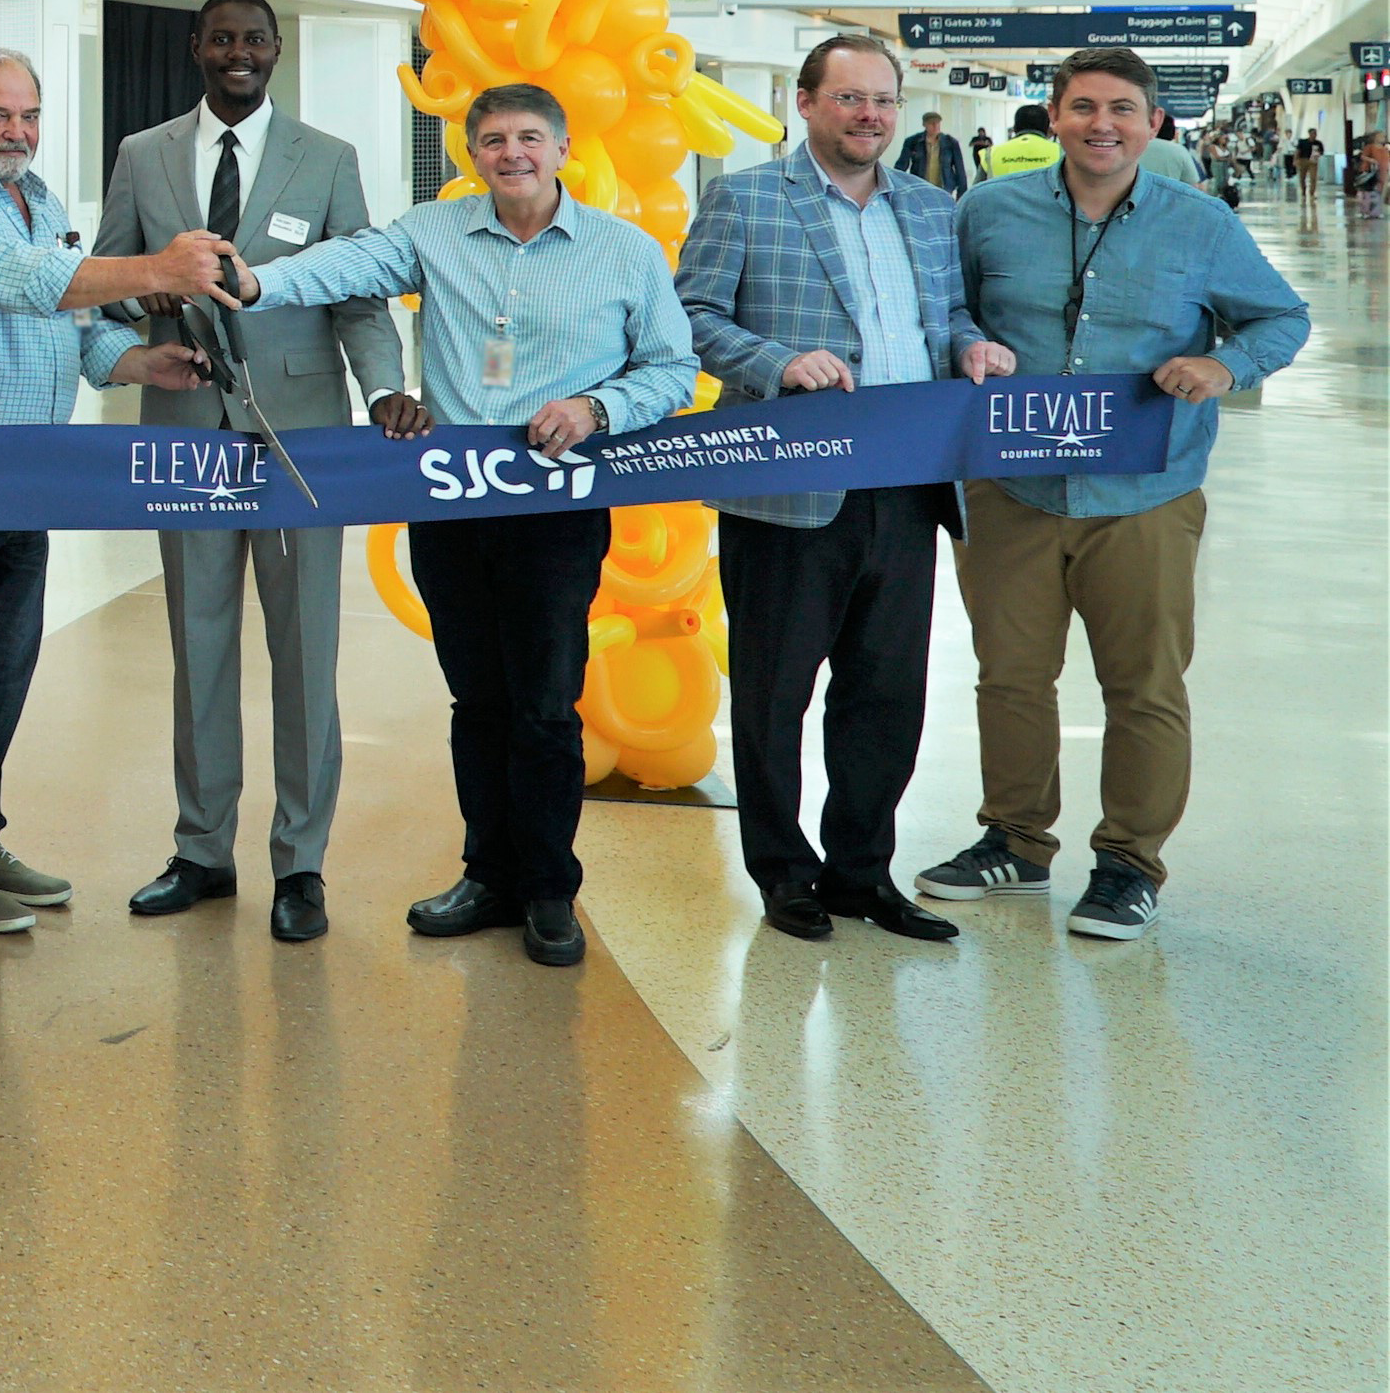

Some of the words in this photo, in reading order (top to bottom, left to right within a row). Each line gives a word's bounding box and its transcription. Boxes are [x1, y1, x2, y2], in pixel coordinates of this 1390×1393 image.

[944, 18, 972, 27] Gates
[974, 18, 1002, 28] 20-36
[1127, 17, 1173, 28] Baggage
[1176, 16, 1205, 26] Claim
[944, 34, 995, 43] Restrooms
[1088, 33, 1127, 43] Ground
[1130, 33, 1205, 44] Transportation
[1307, 80, 1324, 93] 21
[989, 391, 1115, 433] ELEVATE
[601, 444, 645, 460] SAN
[649, 434, 697, 453] JOSE
[699, 425, 780, 448] MINETA
[609, 446, 770, 475] INTERNATIONAL
[774, 438, 854, 460] AIRPORT
[1000, 449, 1052, 460] GOURMET
[1055, 448, 1103, 458] BRANDS
[130, 441, 268, 484] ELEVATE
[419, 448, 535, 501] SJC
[146, 502, 205, 512] GOURMET
[208, 501, 260, 512] BRANDS
